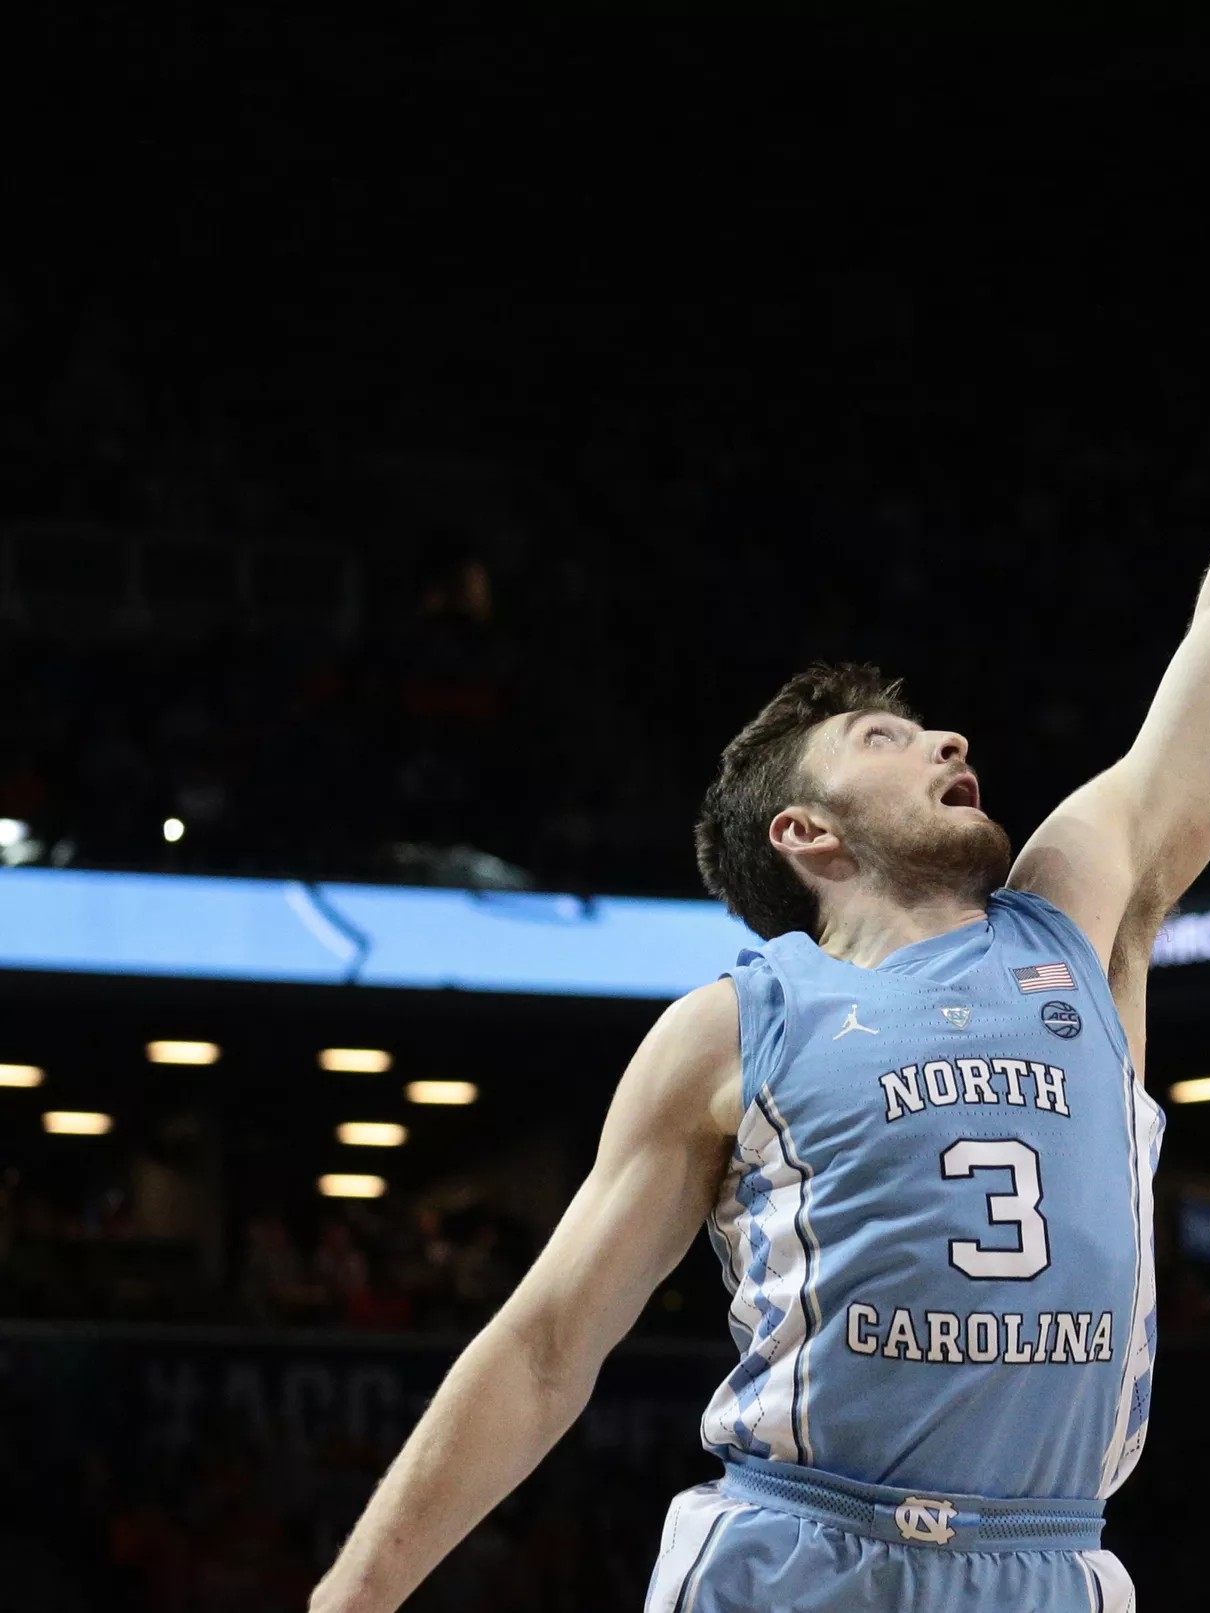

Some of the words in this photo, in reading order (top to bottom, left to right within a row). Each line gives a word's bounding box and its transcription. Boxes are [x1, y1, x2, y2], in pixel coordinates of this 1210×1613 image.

[1049, 1011, 1078, 1021] ACC
[879, 1058, 1070, 1123] NORTH
[940, 1138, 1051, 1281] 3
[846, 1302, 1114, 1364] CAROLINA
